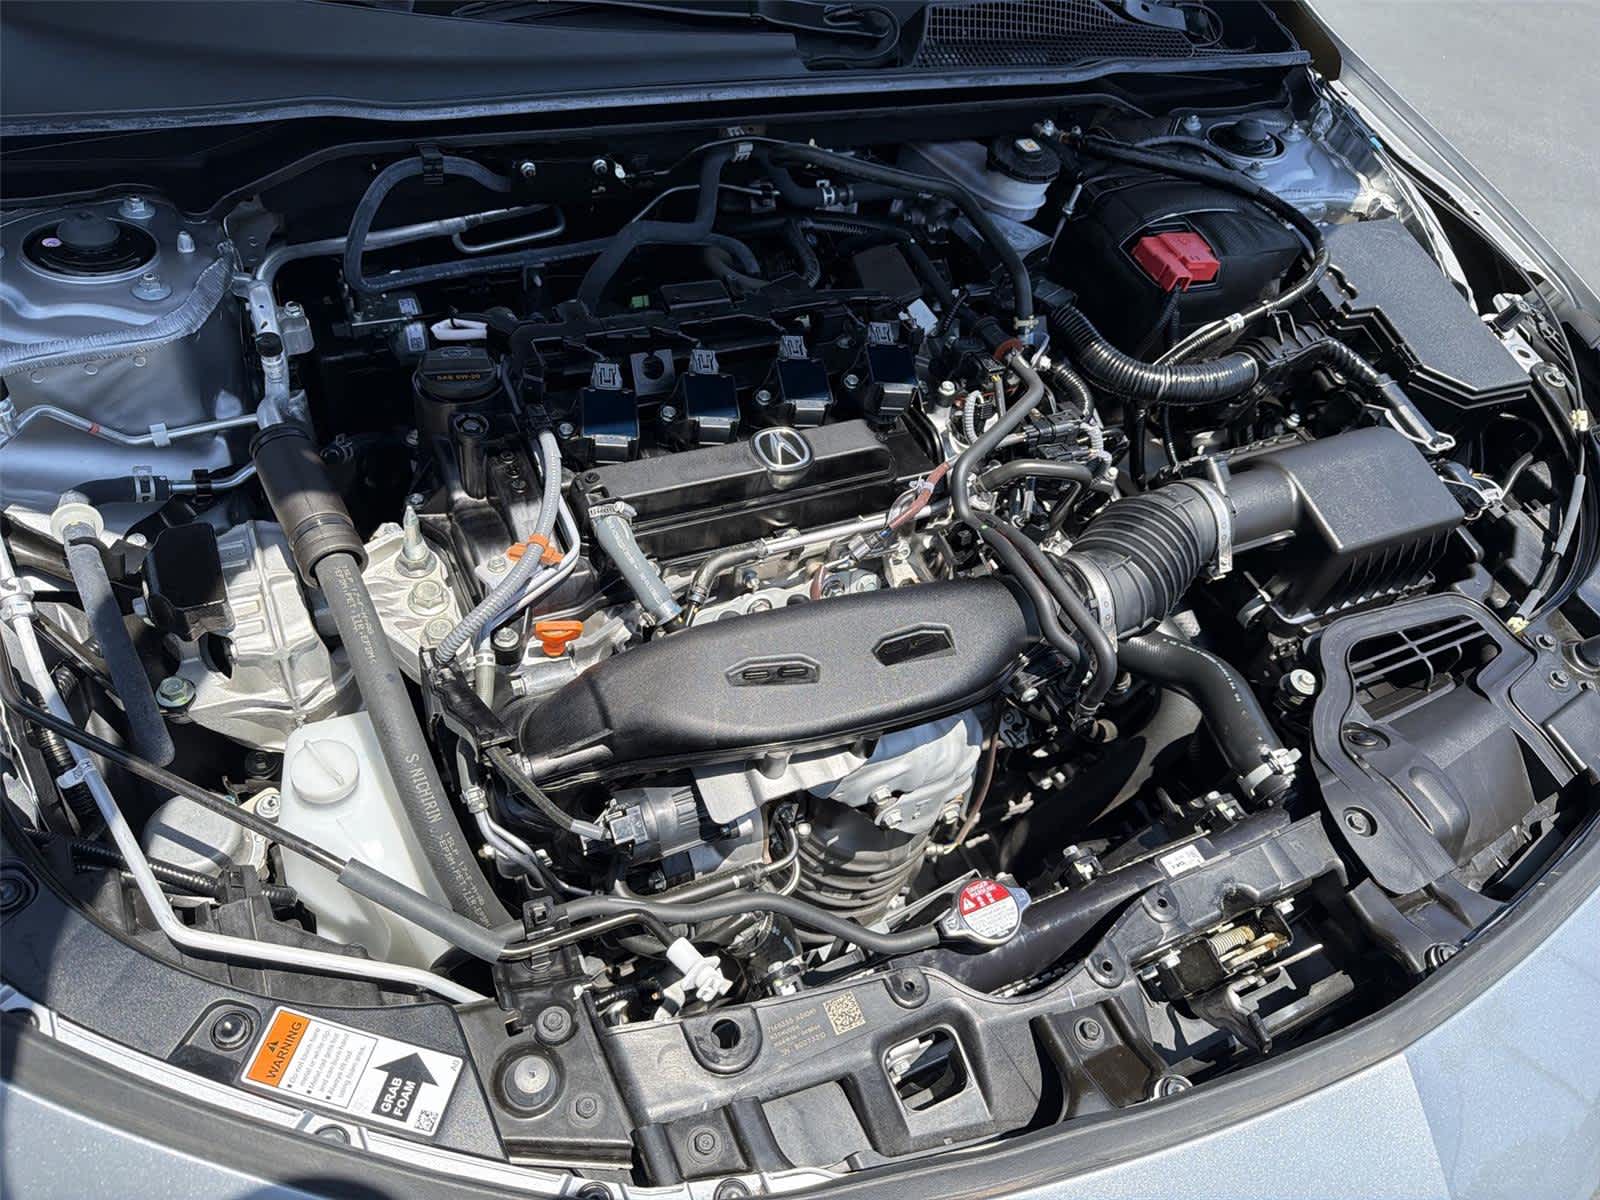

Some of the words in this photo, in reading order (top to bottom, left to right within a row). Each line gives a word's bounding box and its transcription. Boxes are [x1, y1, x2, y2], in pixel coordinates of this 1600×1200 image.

[410, 767, 444, 825] NICHIRIN
[266, 1021, 302, 1079] WARNING
[381, 1078, 403, 1114] GRAB
[394, 1081, 417, 1117] FOAM
